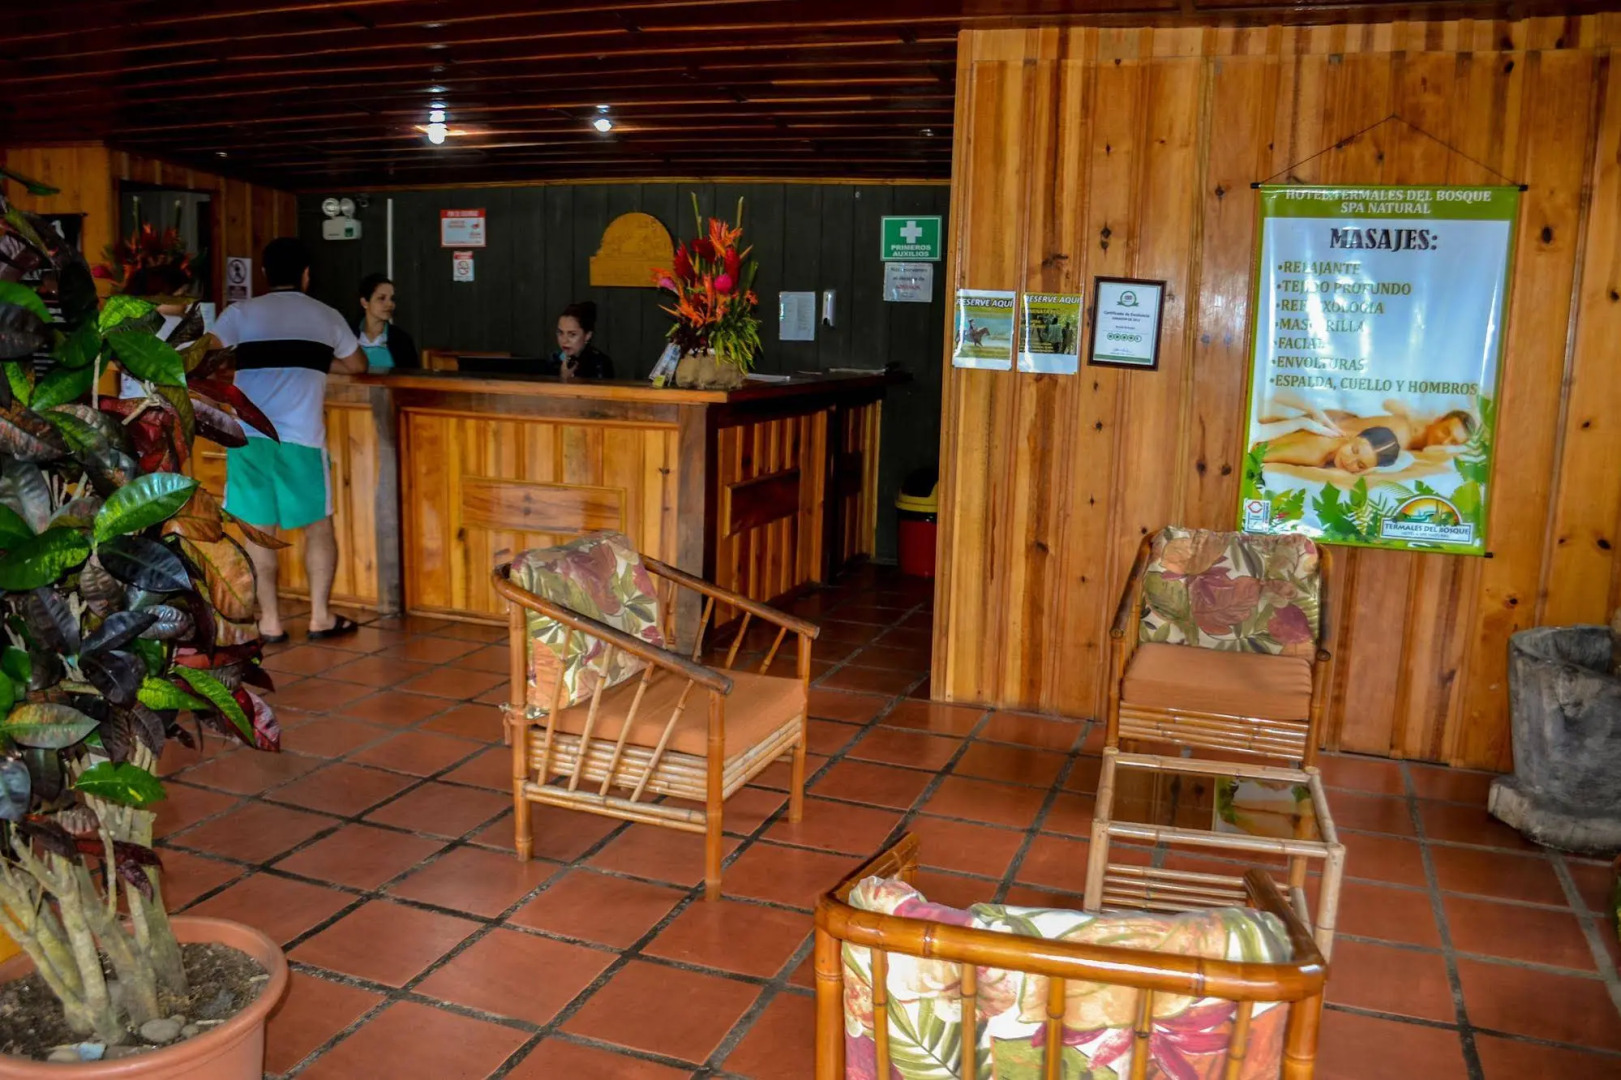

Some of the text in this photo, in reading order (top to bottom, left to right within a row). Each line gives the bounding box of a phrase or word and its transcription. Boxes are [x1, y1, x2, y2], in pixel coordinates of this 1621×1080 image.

[1332, 190, 1404, 201] TERMALES
[1406, 190, 1433, 201] DEL
[1436, 190, 1492, 205] BOSQUE
[1340, 202, 1431, 214] SPA NATURAL
[1329, 227, 1439, 253] MASAJES:
[1282, 261, 1361, 276] RELAJANTE
[1281, 280, 1412, 295] TEJO PROFUNDO
[1281, 299, 1385, 314] REFXOLOGIA
[1279, 318, 1365, 333] MASRILLA
[1275, 375, 1478, 395] ESPALDA, CUELLO Y HOMBROS
[1385, 523, 1423, 531] TERMALES
[1424, 525, 1438, 533] DEL
